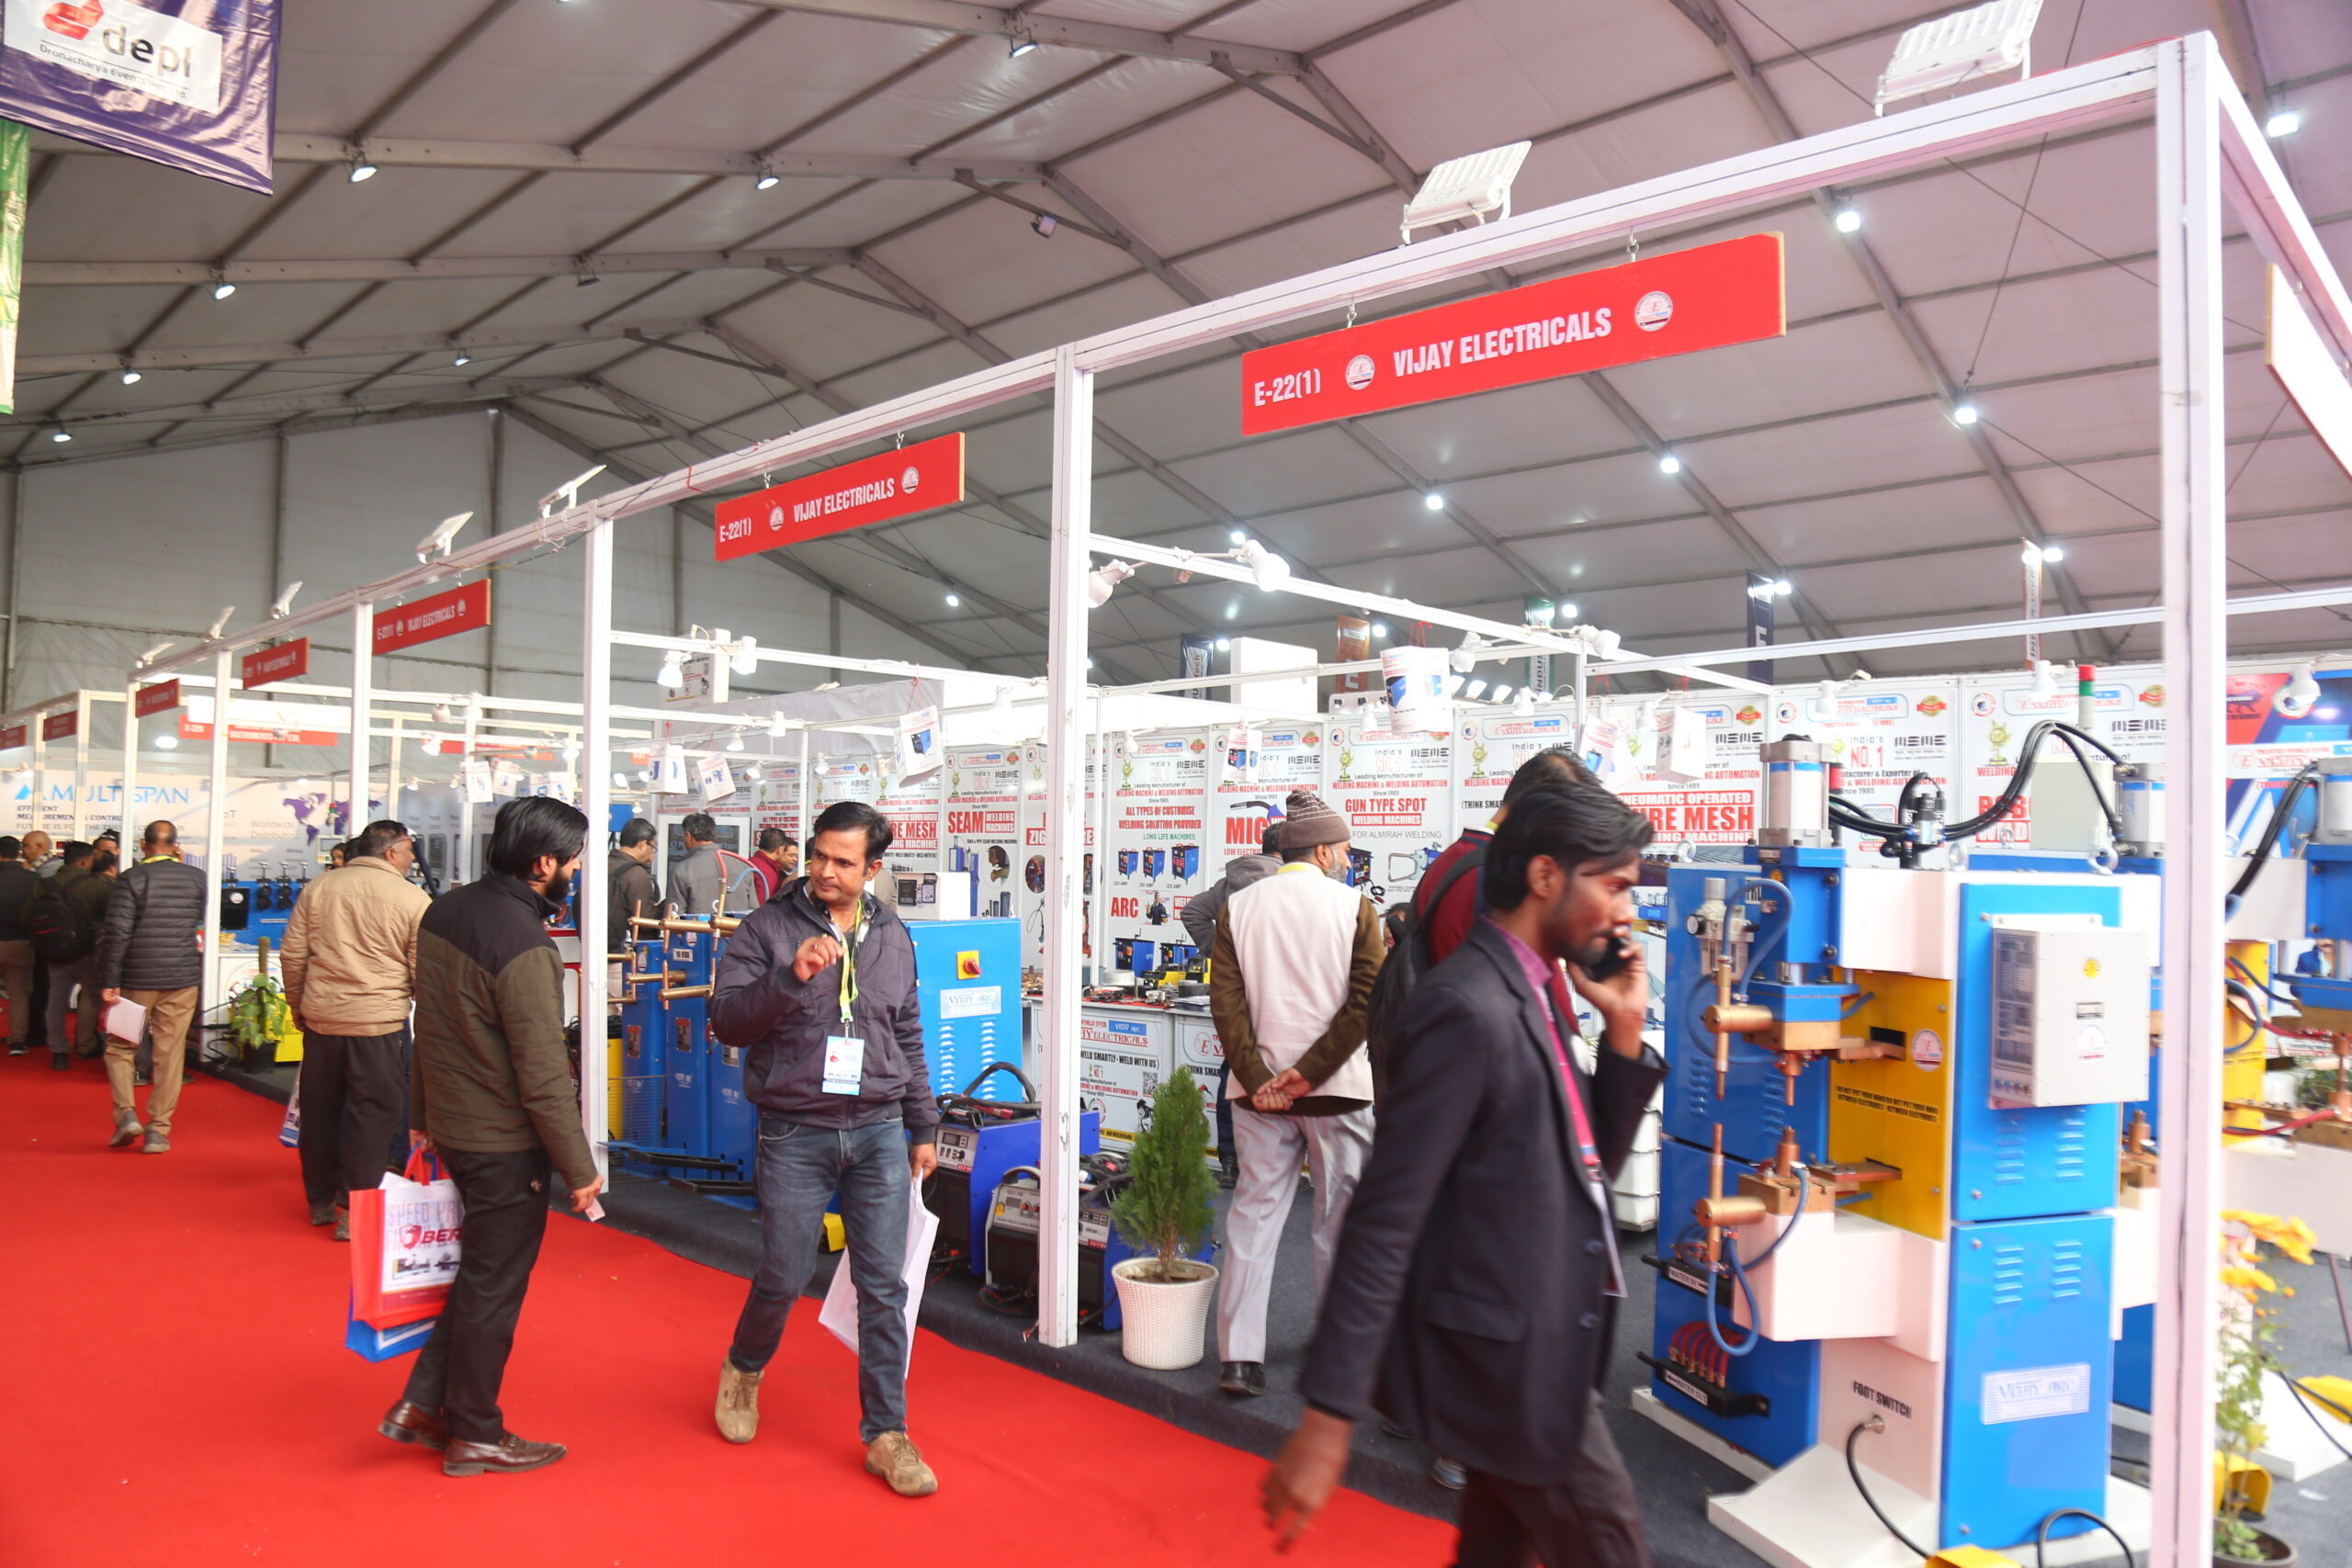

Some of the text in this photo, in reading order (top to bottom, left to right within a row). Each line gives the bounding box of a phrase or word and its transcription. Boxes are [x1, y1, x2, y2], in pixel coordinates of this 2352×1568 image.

[103, 24, 191, 77] depl
[40, 44, 107, 74] Dronacharya
[1254, 308, 1612, 407] E-22(1) VIJAY ELECTRICALS
[719, 478, 895, 543] E-22(1) VIJAY ELECTRICALS
[1715, 770, 1760, 779] AUTOMATION
[1882, 770, 1911, 778] Exporter
[1977, 766, 2017, 777] WELDING
[1217, 785, 1238, 794] WELDING
[1239, 784, 1261, 793] MACHINE
[1288, 784, 1317, 792] AUTOMATION
[1855, 778, 1891, 786] WELDING
[51, 784, 189, 805] MULTSPAN
[1687, 792, 1751, 804] OPERATED
[1125, 807, 1136, 816] ALL
[1136, 807, 1153, 816] TYPES
[1155, 807, 1161, 816] OF
[1345, 797, 1427, 812] GUN TYPE SPOT
[250, 820, 296, 829] Worldwide
[947, 811, 1014, 834] SEAM WELDING
[1119, 819, 1201, 829] WELDING SOLUTION PROVIDER
[1353, 815, 1420, 824] WELDING MACHINES
[1684, 807, 1754, 830] MESH
[904, 822, 937, 838] MESH
[986, 823, 1014, 832] MACHINES
[905, 839, 937, 849] MACHINE
[1689, 832, 1753, 842] MACHINE
[1111, 897, 1139, 918] ARC
[1094, 1052, 1116, 1063] SMARTLY
[1119, 1055, 1133, 1065] WELD
[1134, 1057, 1148, 1066] WITH
[1670, 1269, 1690, 1284] WATER
[1676, 1380, 1708, 1404] WATER OUT
[1853, 1381, 1912, 1419] FOOT SWITCH
